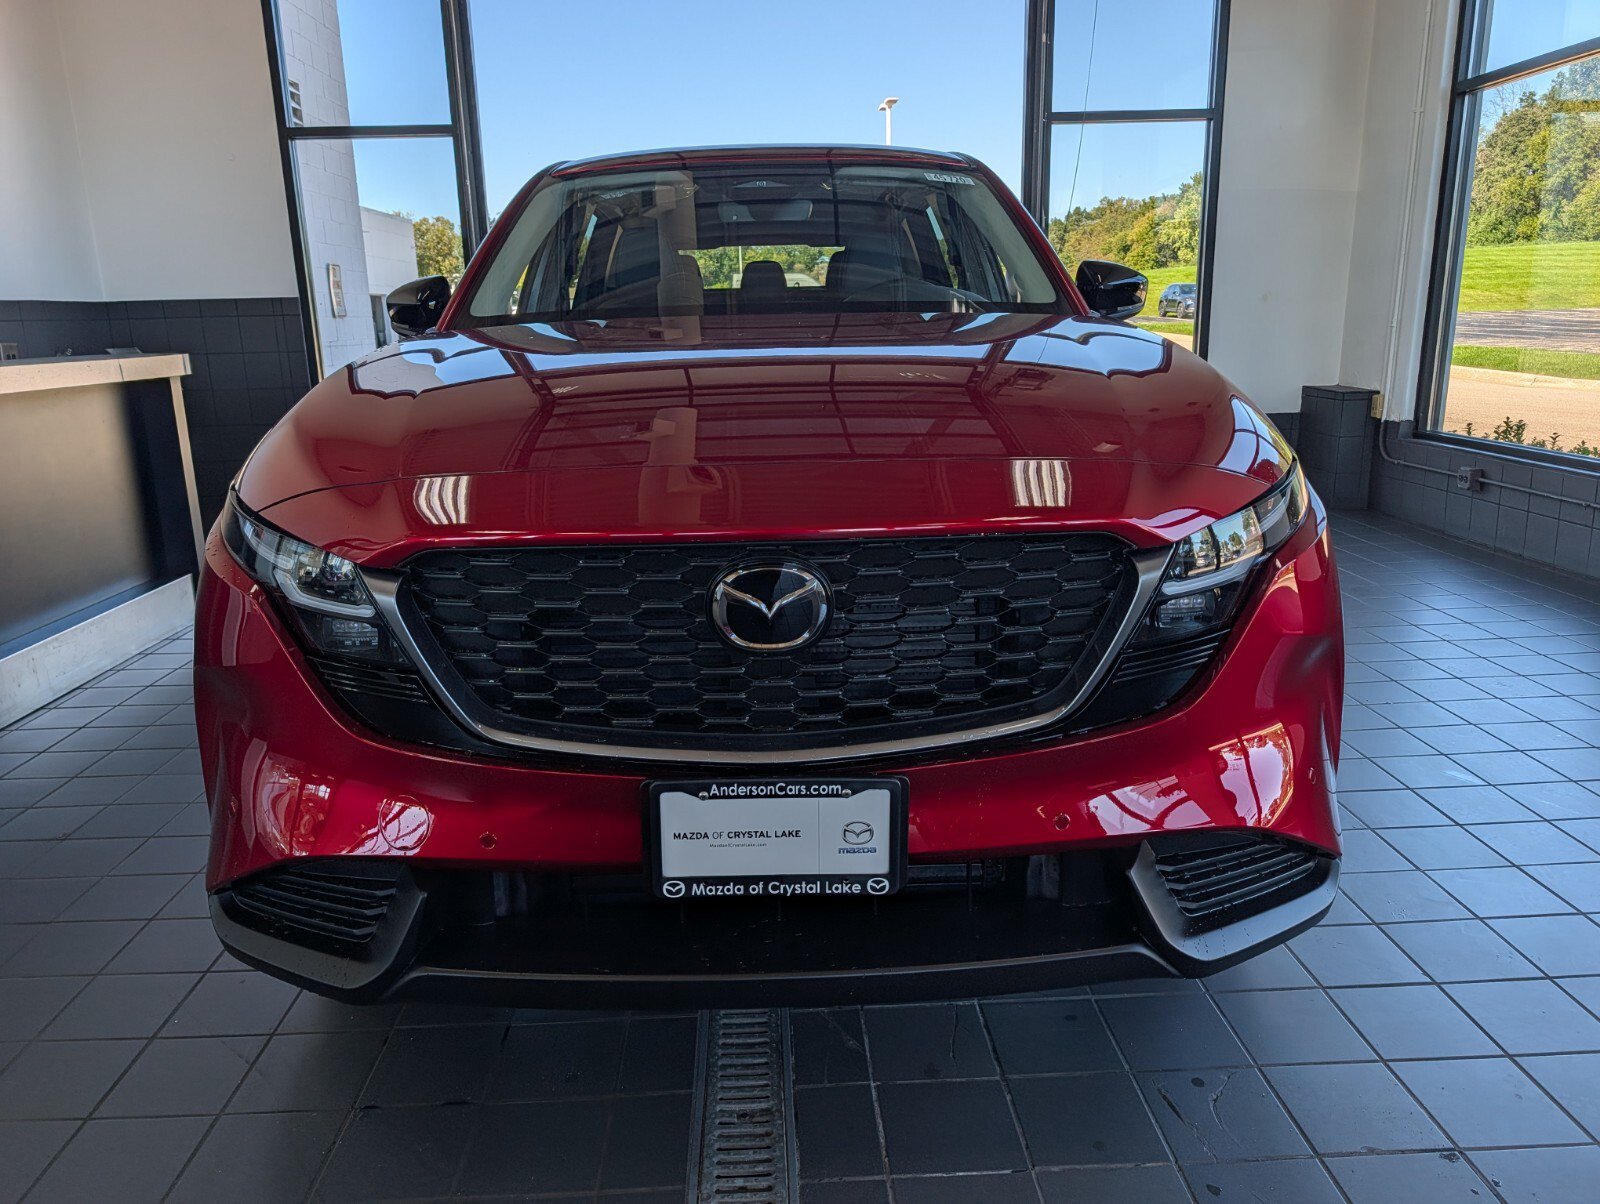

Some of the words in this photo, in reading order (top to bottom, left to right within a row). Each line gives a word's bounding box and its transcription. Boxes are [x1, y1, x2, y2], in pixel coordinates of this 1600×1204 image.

[709, 782, 842, 797] AndersonCars.com
[673, 832, 709, 841] MAZDA
[711, 831, 725, 840] OF
[727, 830, 771, 839] CRYSTAL
[774, 829, 801, 838] LAKE
[691, 882, 744, 896] Mazda
[749, 881, 763, 895] of
[768, 880, 820, 897] Crystal
[825, 881, 861, 894] Lake
